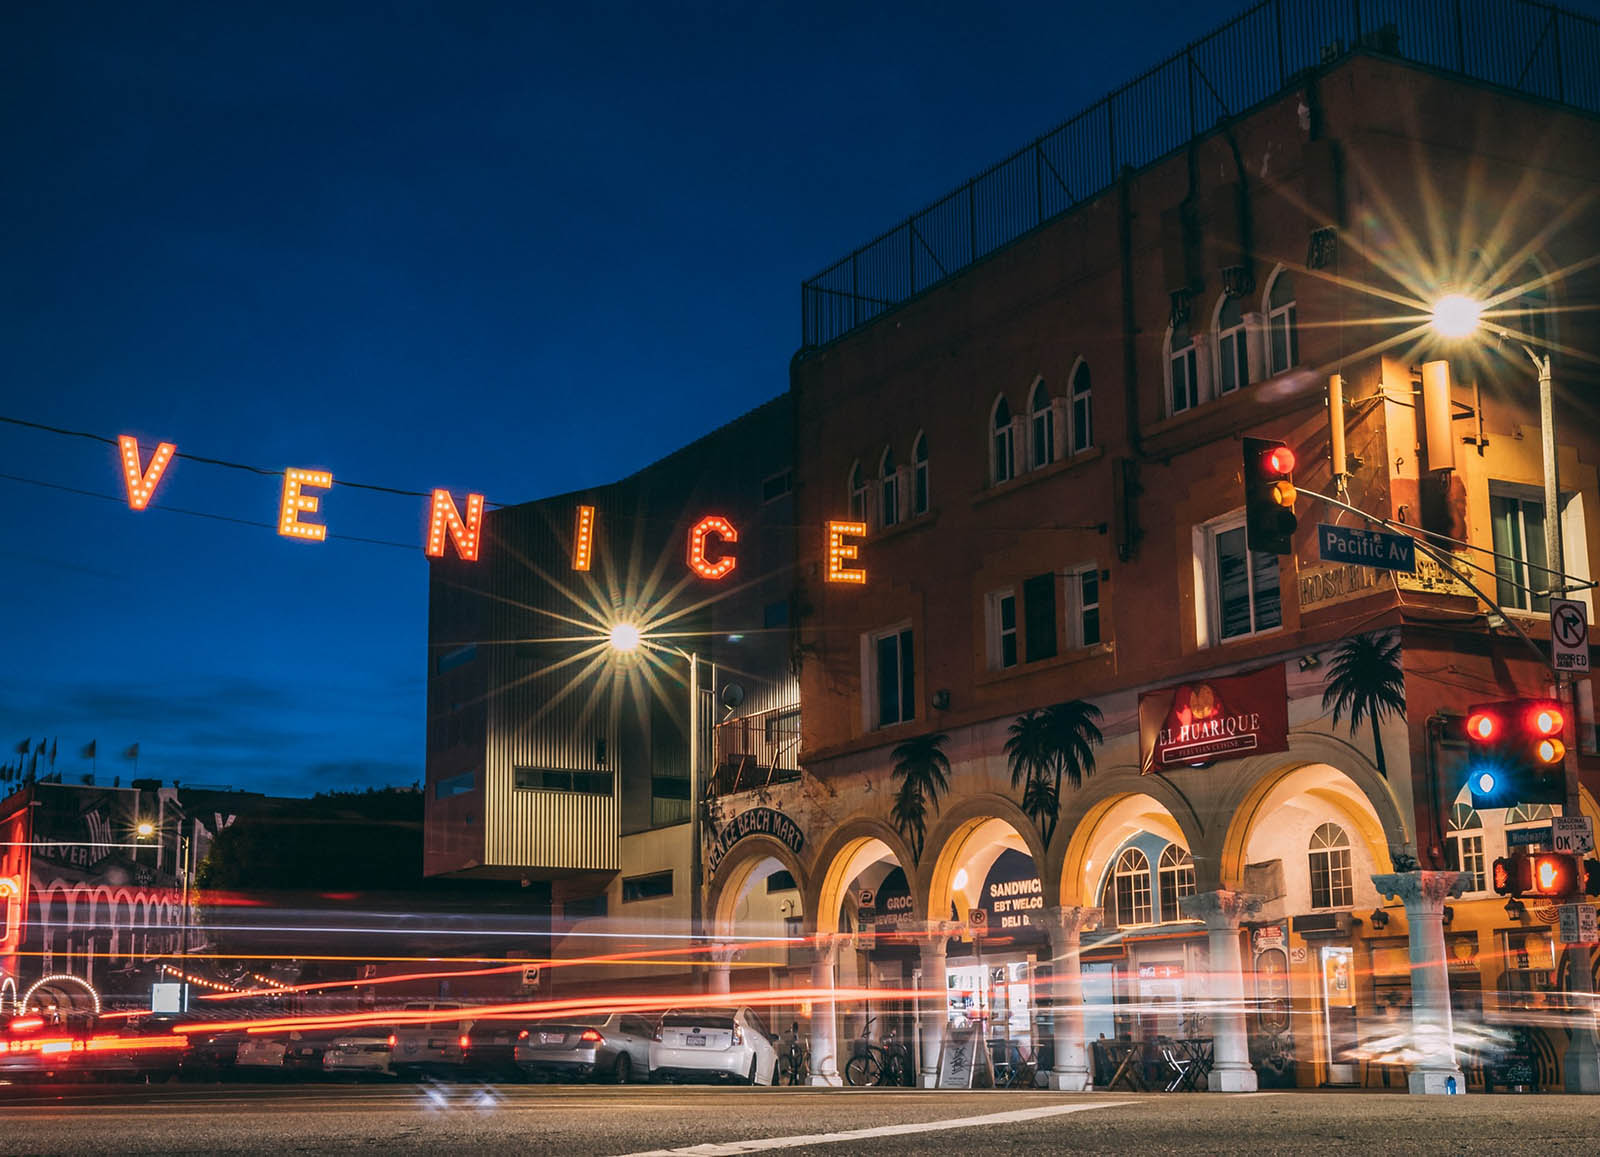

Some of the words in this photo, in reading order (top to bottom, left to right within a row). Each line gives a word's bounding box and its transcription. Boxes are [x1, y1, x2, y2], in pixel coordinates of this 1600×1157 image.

[118, 434, 867, 584] VENICE
[1327, 532, 1384, 559] Pacific
[1389, 542, 1408, 561] Av
[1159, 728, 1177, 746] EL
[1180, 713, 1260, 743] HUARIQUE
[738, 809, 770, 836] BEACH
[773, 812, 801, 852] MART
[1556, 836, 1571, 850] OK
[32, 833, 88, 866] NEVER
[994, 900, 1011, 912] EBT
[1012, 896, 1043, 910] WELCO
[1001, 915, 1021, 928] DELI
[1023, 914, 1032, 926] D
